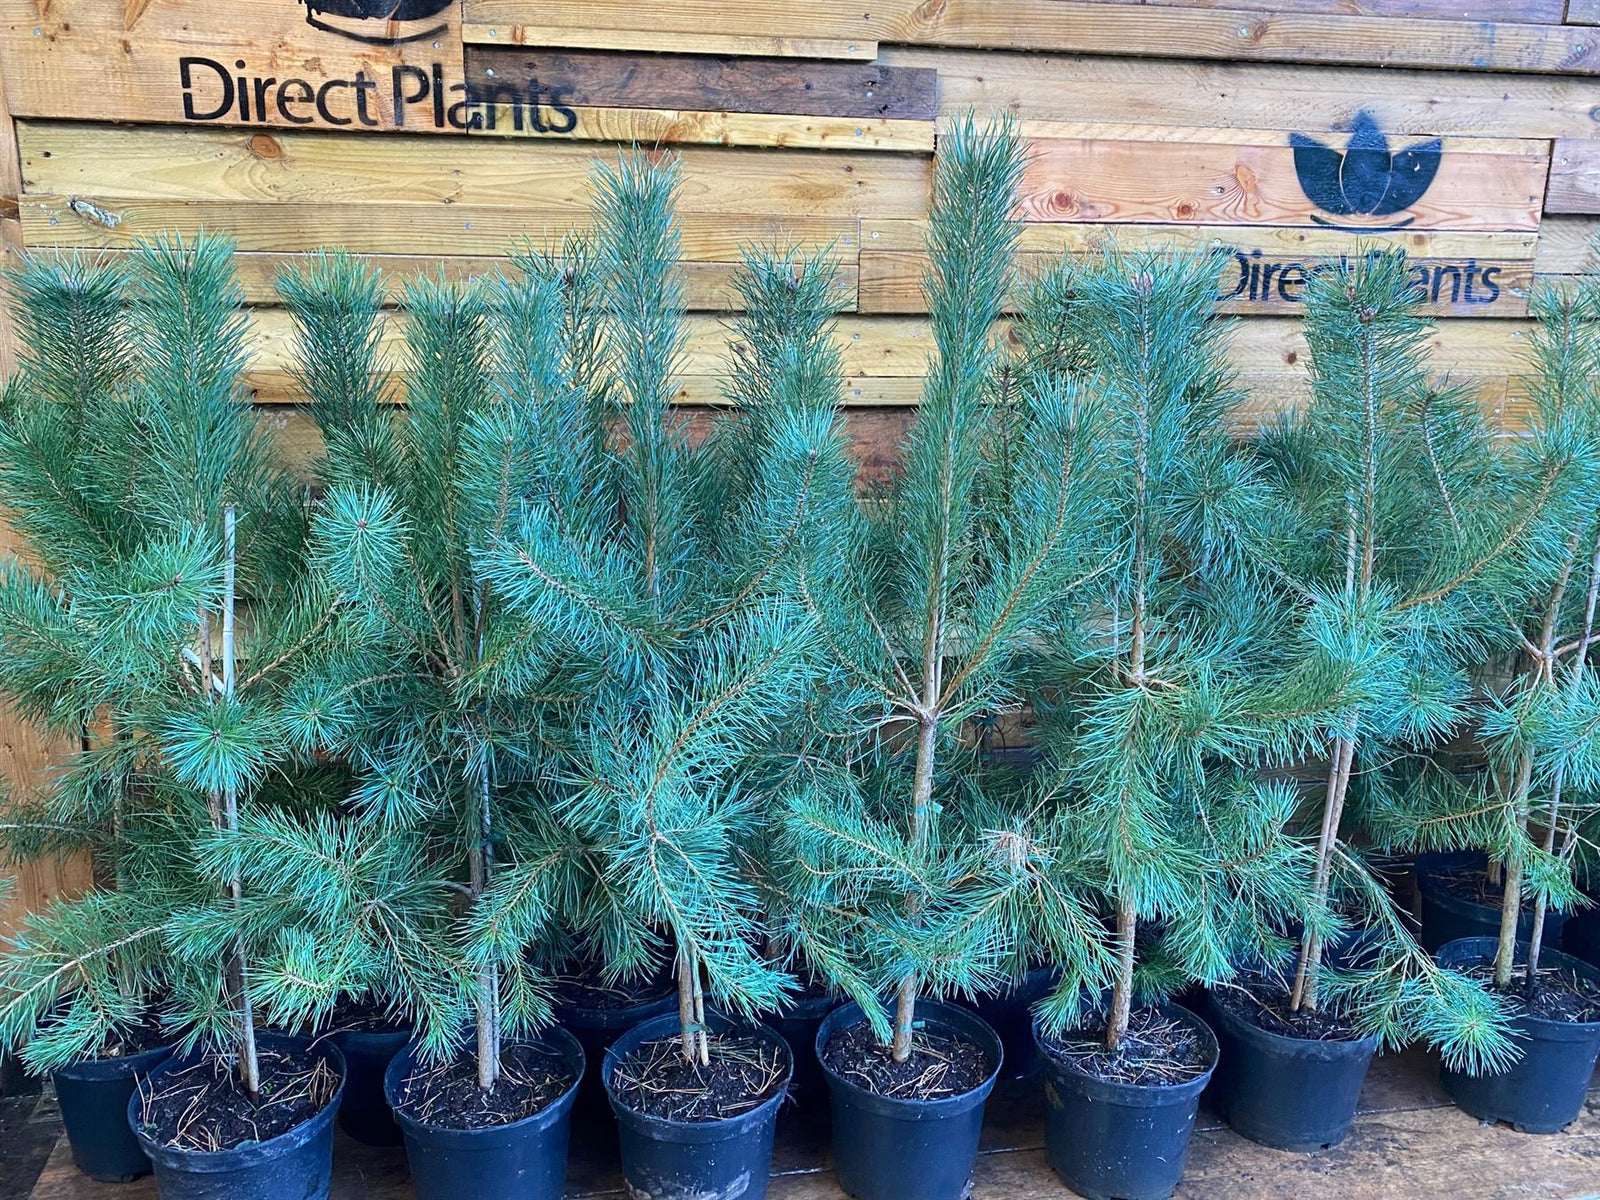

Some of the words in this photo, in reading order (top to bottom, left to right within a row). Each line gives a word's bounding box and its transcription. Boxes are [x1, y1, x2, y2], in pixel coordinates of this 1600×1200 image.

[179, 56, 378, 126] Direct
[392, 63, 577, 133] Plants
[1211, 247, 1355, 302] Dire
